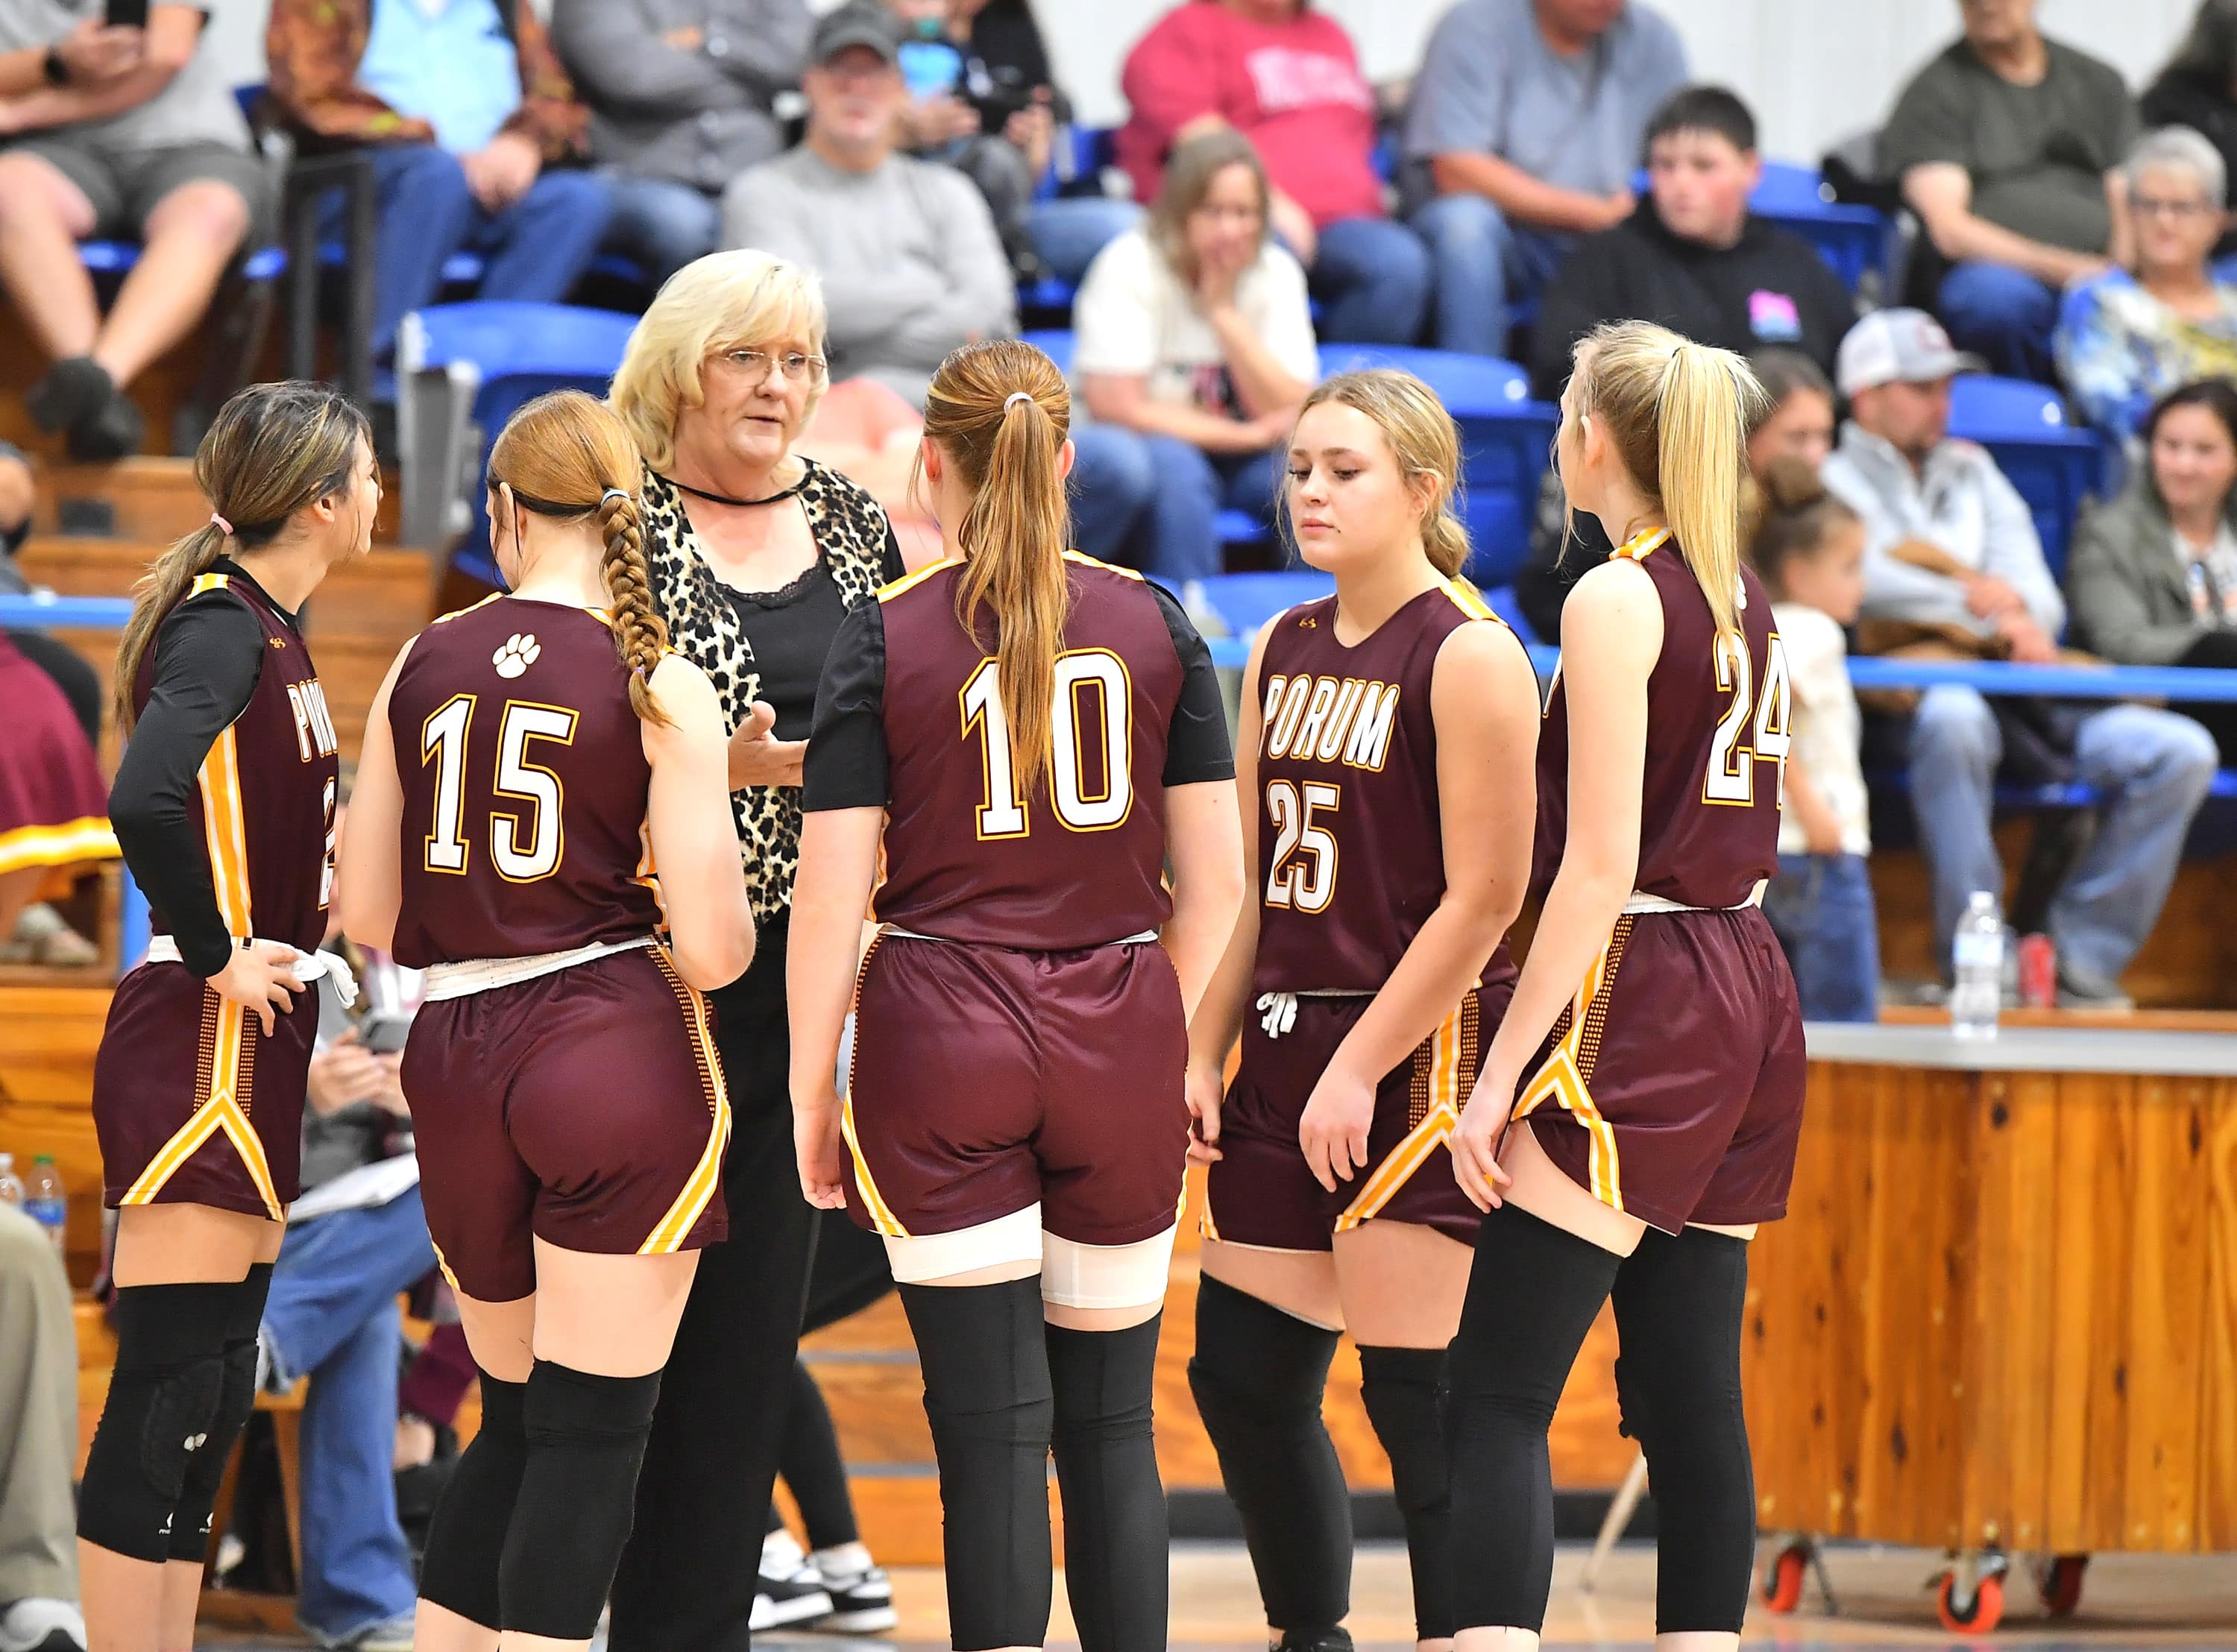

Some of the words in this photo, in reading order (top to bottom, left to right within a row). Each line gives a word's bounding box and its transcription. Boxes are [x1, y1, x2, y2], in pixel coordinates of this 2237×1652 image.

[421, 693, 580, 883] 15
[958, 646, 1133, 841] 10
[1258, 674, 1400, 772] PORUM
[1702, 627, 1792, 810] 24
[1265, 779, 1341, 914] 25
